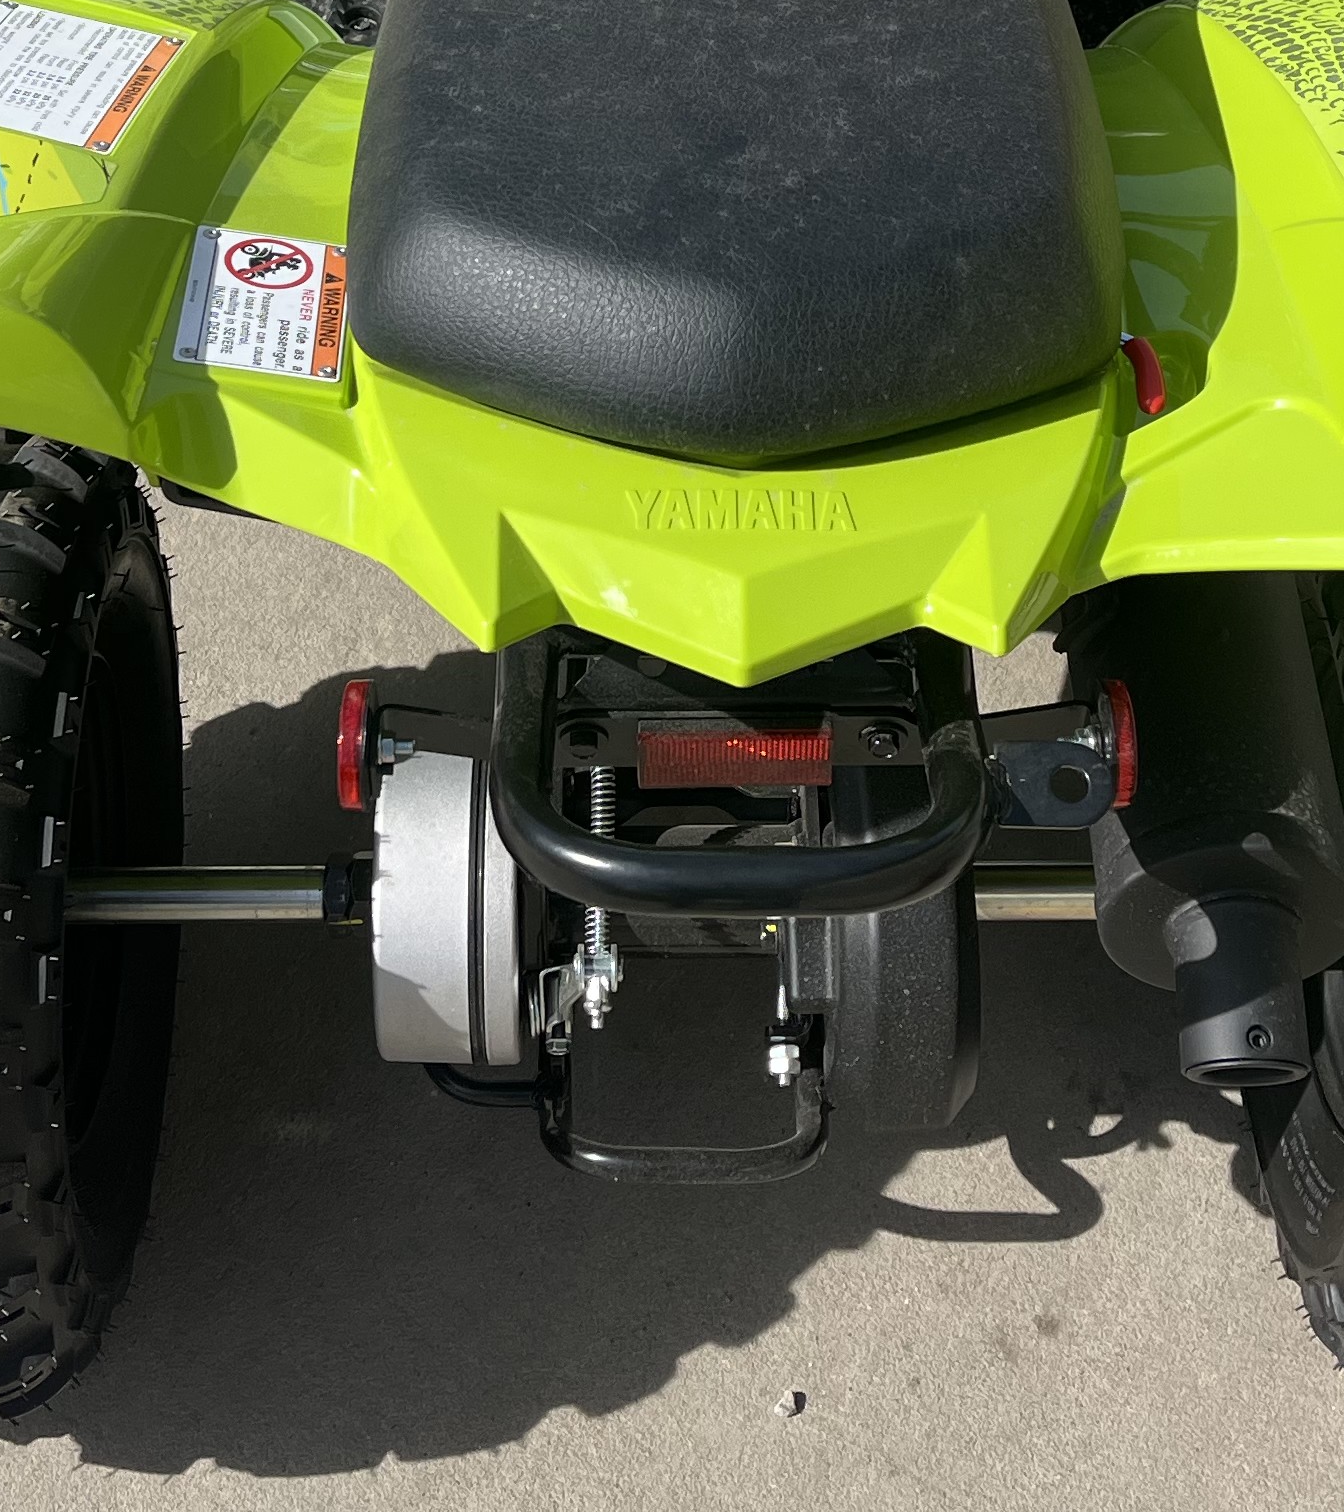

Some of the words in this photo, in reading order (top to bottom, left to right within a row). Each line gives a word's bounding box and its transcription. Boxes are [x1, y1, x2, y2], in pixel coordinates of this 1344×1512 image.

[112, 74, 150, 113] WARNING
[210, 285, 225, 309] INJURY
[223, 287, 239, 315] resulting
[244, 296, 255, 309] loss
[256, 292, 274, 328] Passengers
[299, 289, 314, 321] NEVER
[209, 310, 219, 319] or
[318, 292, 342, 348] WARNING
[220, 327, 236, 354] SEVERE
[256, 331, 266, 343] can
[273, 319, 290, 367] passenger.
[296, 326, 309, 344] ride
[252, 346, 263, 365] cause
[293, 349, 304, 360] as
[624, 489, 858, 531] YAMAHA
